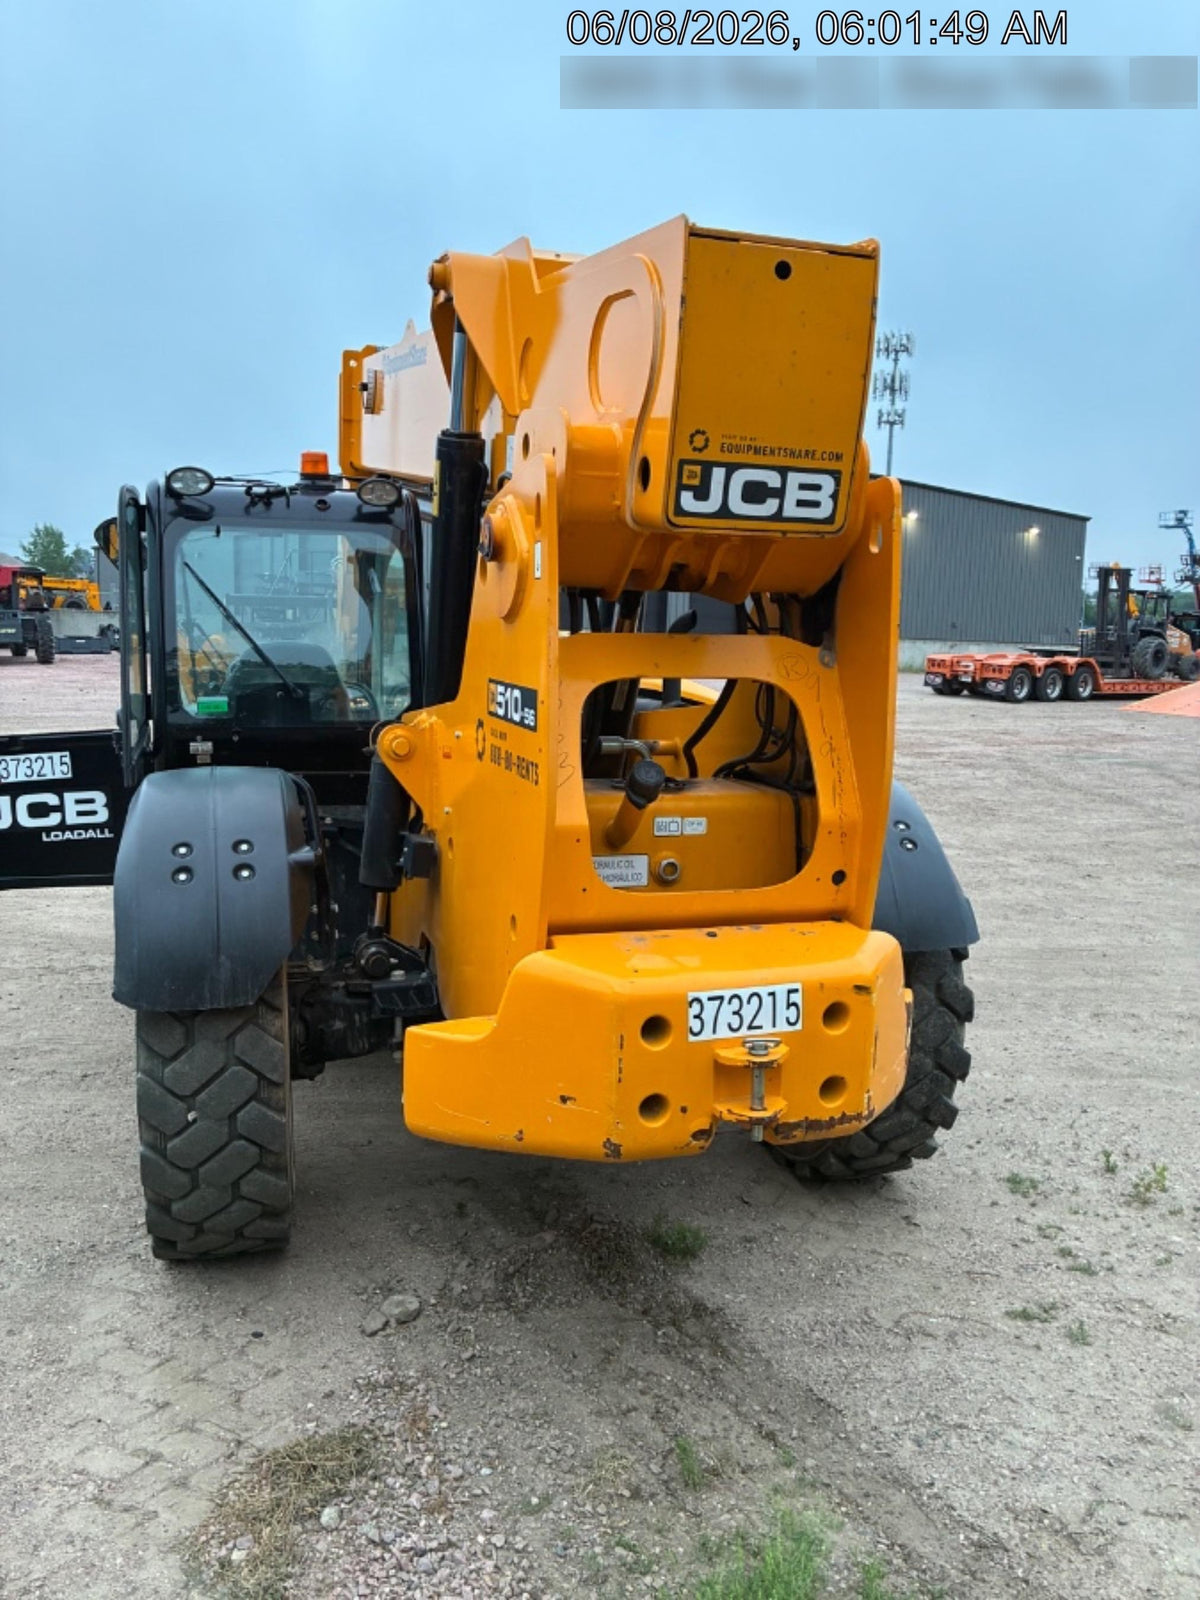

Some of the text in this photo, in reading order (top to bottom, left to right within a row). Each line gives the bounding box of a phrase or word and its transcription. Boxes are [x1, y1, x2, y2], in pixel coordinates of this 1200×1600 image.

[680, 466, 836, 520] JCB
[0, 755, 70, 780] 373215
[42, 827, 114, 842] LOADALL
[688, 987, 801, 1037] 373215
